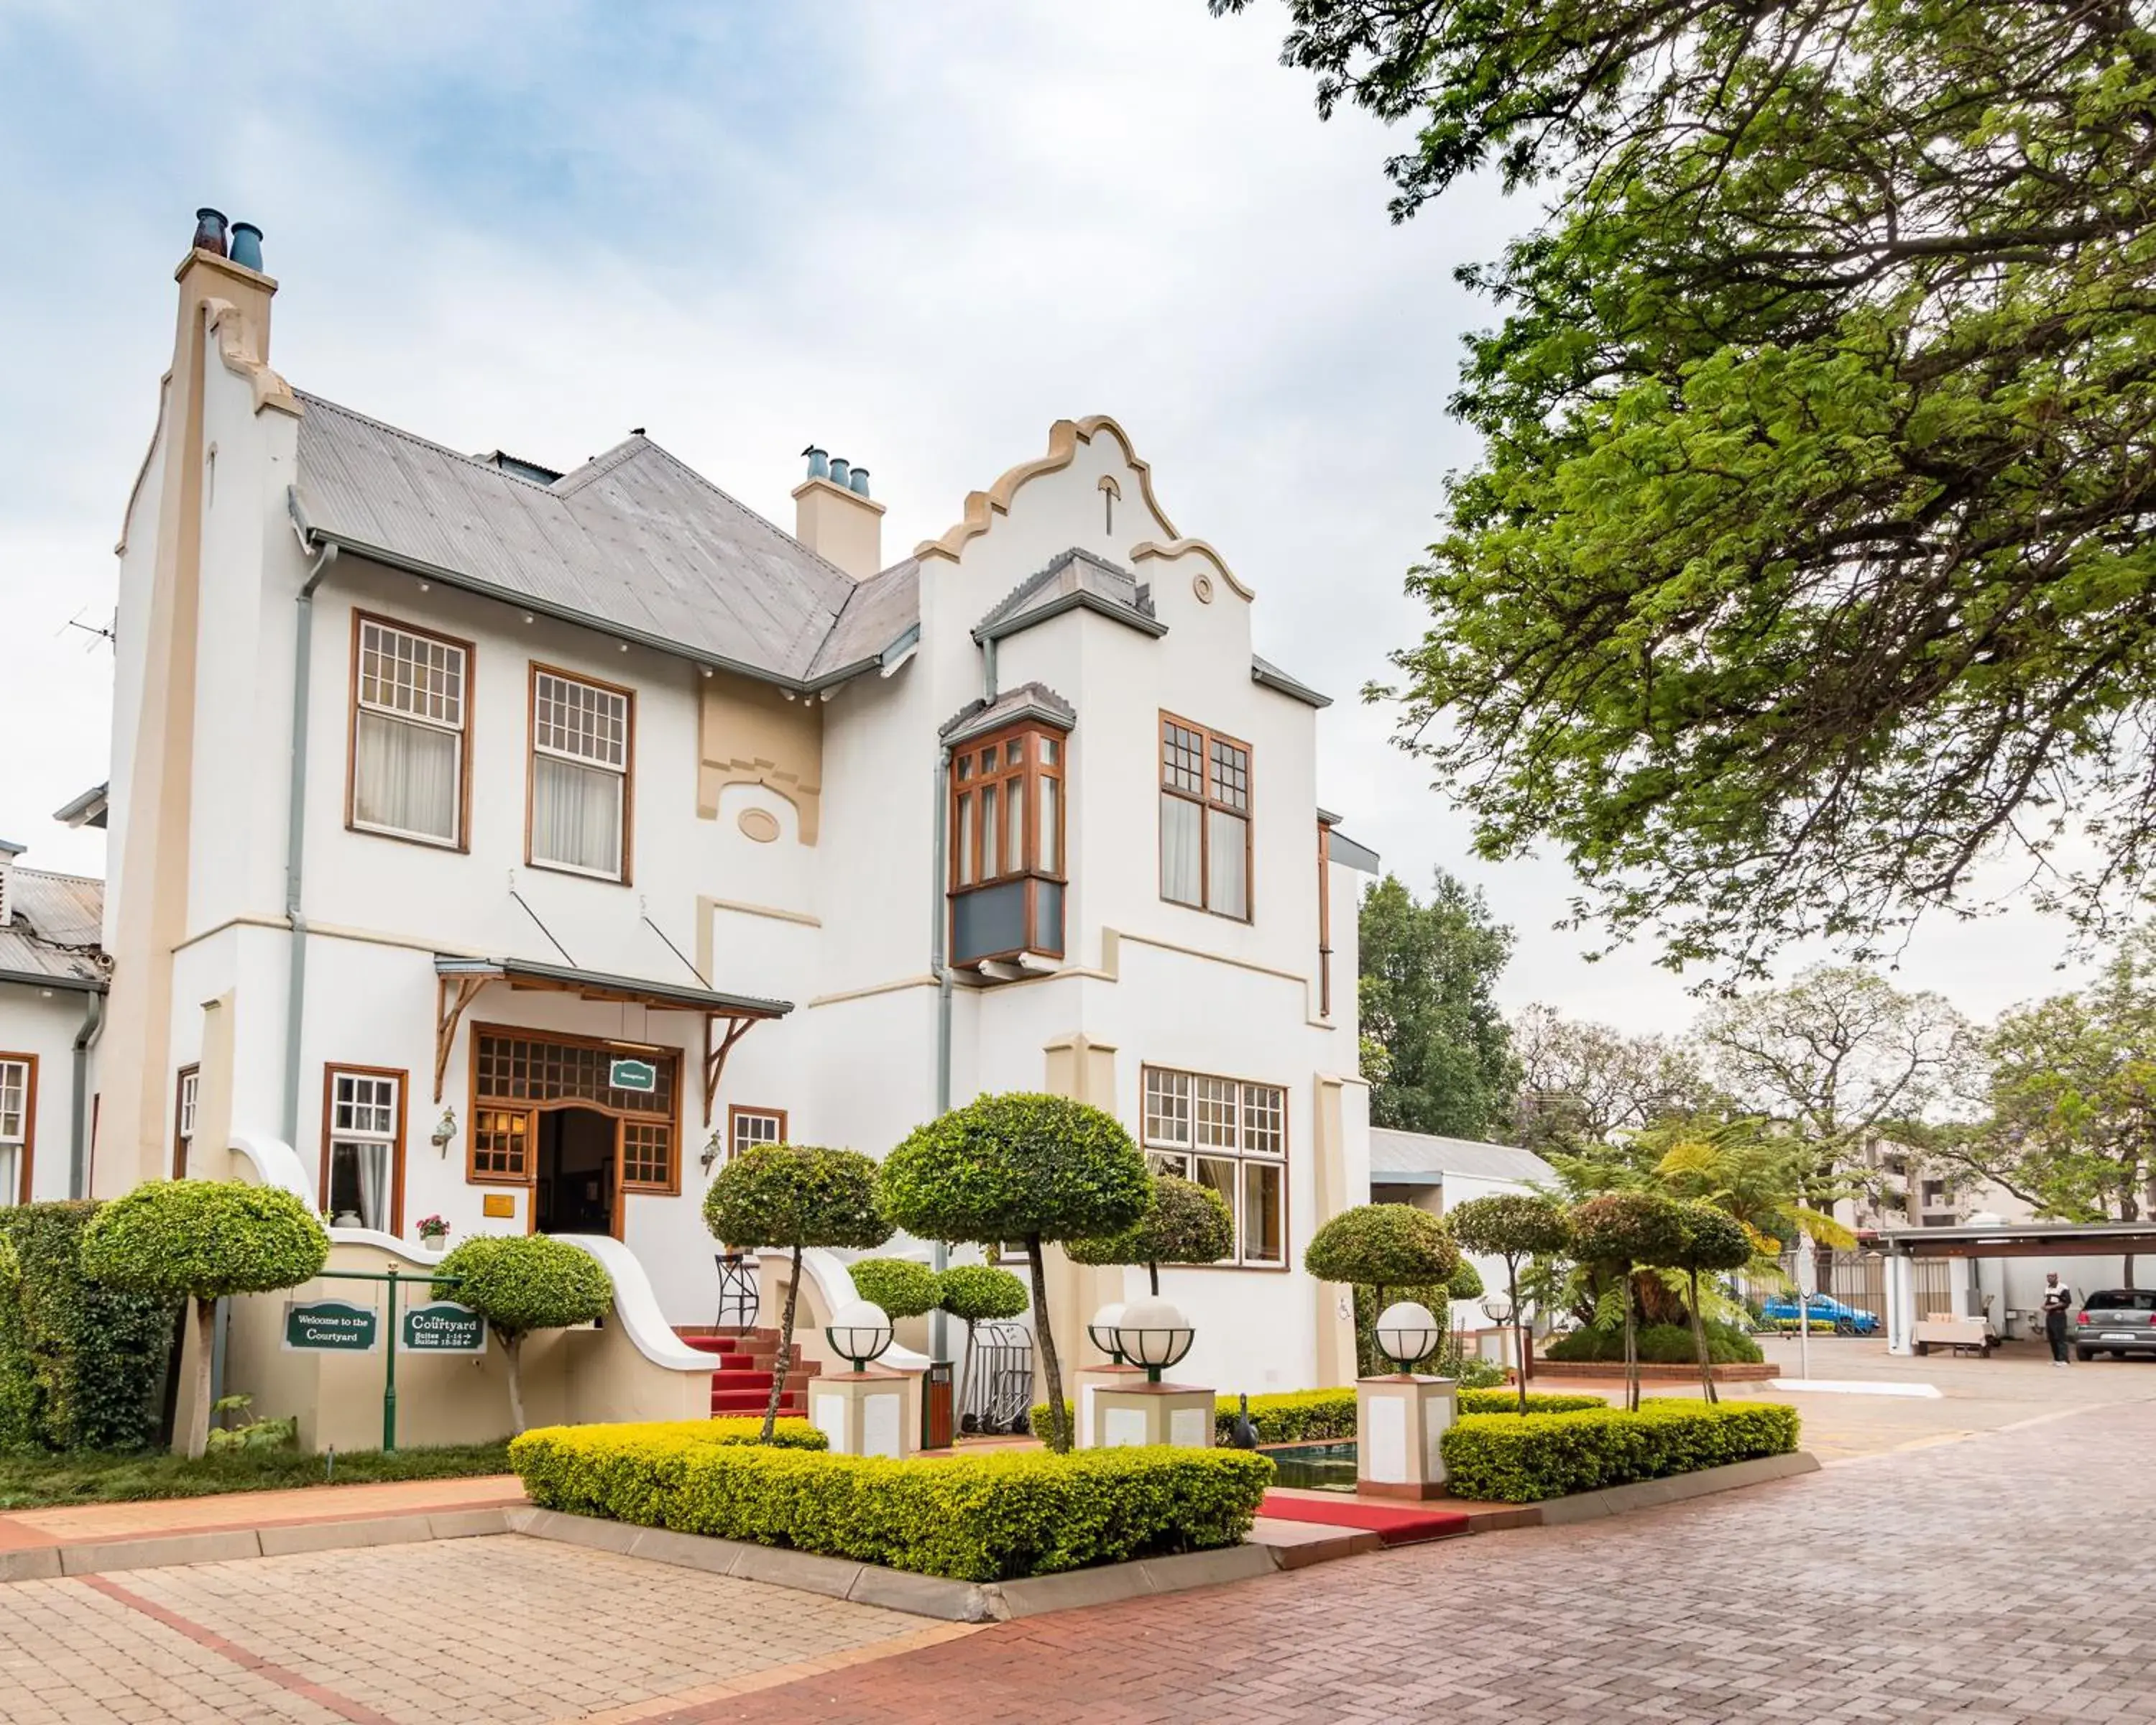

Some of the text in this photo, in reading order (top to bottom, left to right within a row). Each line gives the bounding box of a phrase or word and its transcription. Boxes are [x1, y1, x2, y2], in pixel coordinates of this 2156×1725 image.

[298, 1315, 338, 1325] Welcome
[353, 1318, 368, 1327] the
[412, 1315, 476, 1331] Courtyard
[306, 1328, 357, 1342] Courtyard
